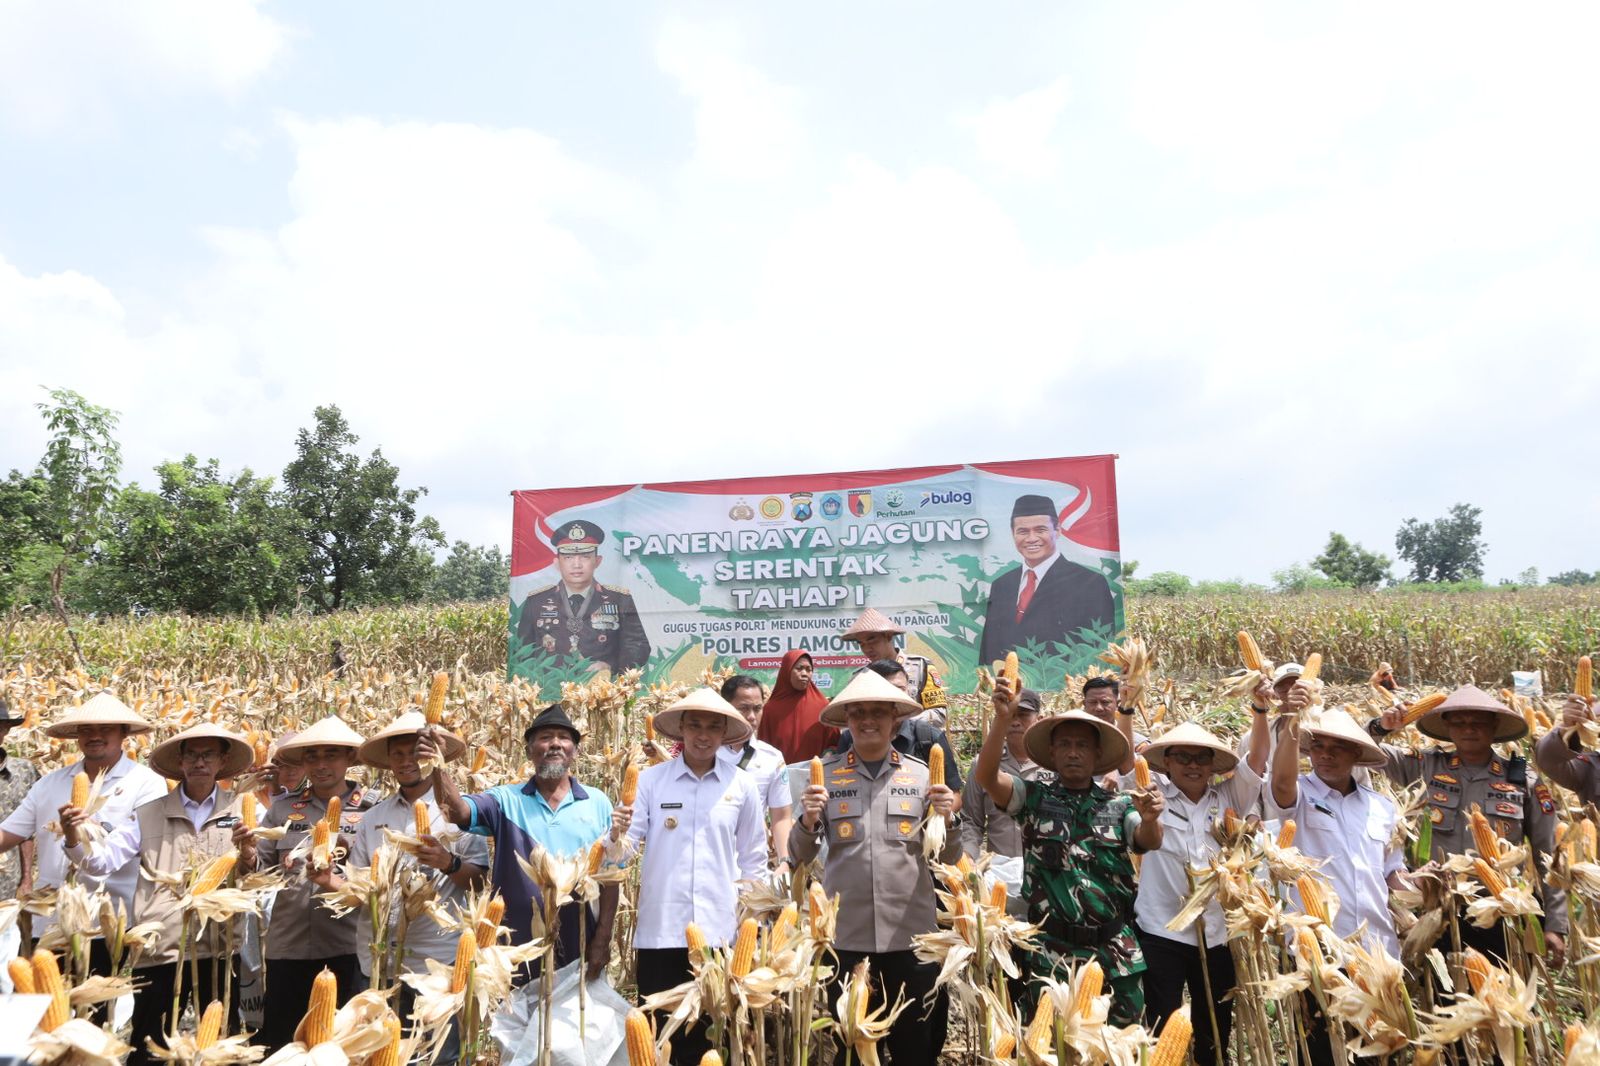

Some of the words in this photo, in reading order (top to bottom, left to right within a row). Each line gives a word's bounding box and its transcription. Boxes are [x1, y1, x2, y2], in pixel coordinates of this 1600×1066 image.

[931, 491, 972, 505] bulog
[876, 510, 916, 518] Perhutani
[622, 531, 732, 556] PANEN
[739, 526, 834, 551] RAYA
[839, 518, 990, 547] JAGUNG
[714, 553, 889, 581] SERENTAK
[731, 585, 849, 610] TAHAP
[855, 585, 865, 606] I
[663, 622, 697, 633] GUGUS
[700, 621, 732, 632] TUGAS
[734, 620, 765, 631] POLRI
[771, 618, 836, 630] MENDUKUNG
[905, 614, 948, 626] PANGAN
[703, 636, 781, 654] POLRES
[787, 633, 905, 652] LAMONN
[812, 658, 848, 666] Februari
[829, 789, 858, 799] BOBBY
[891, 787, 920, 796] POLRI
[1487, 792, 1521, 801] POLRI
